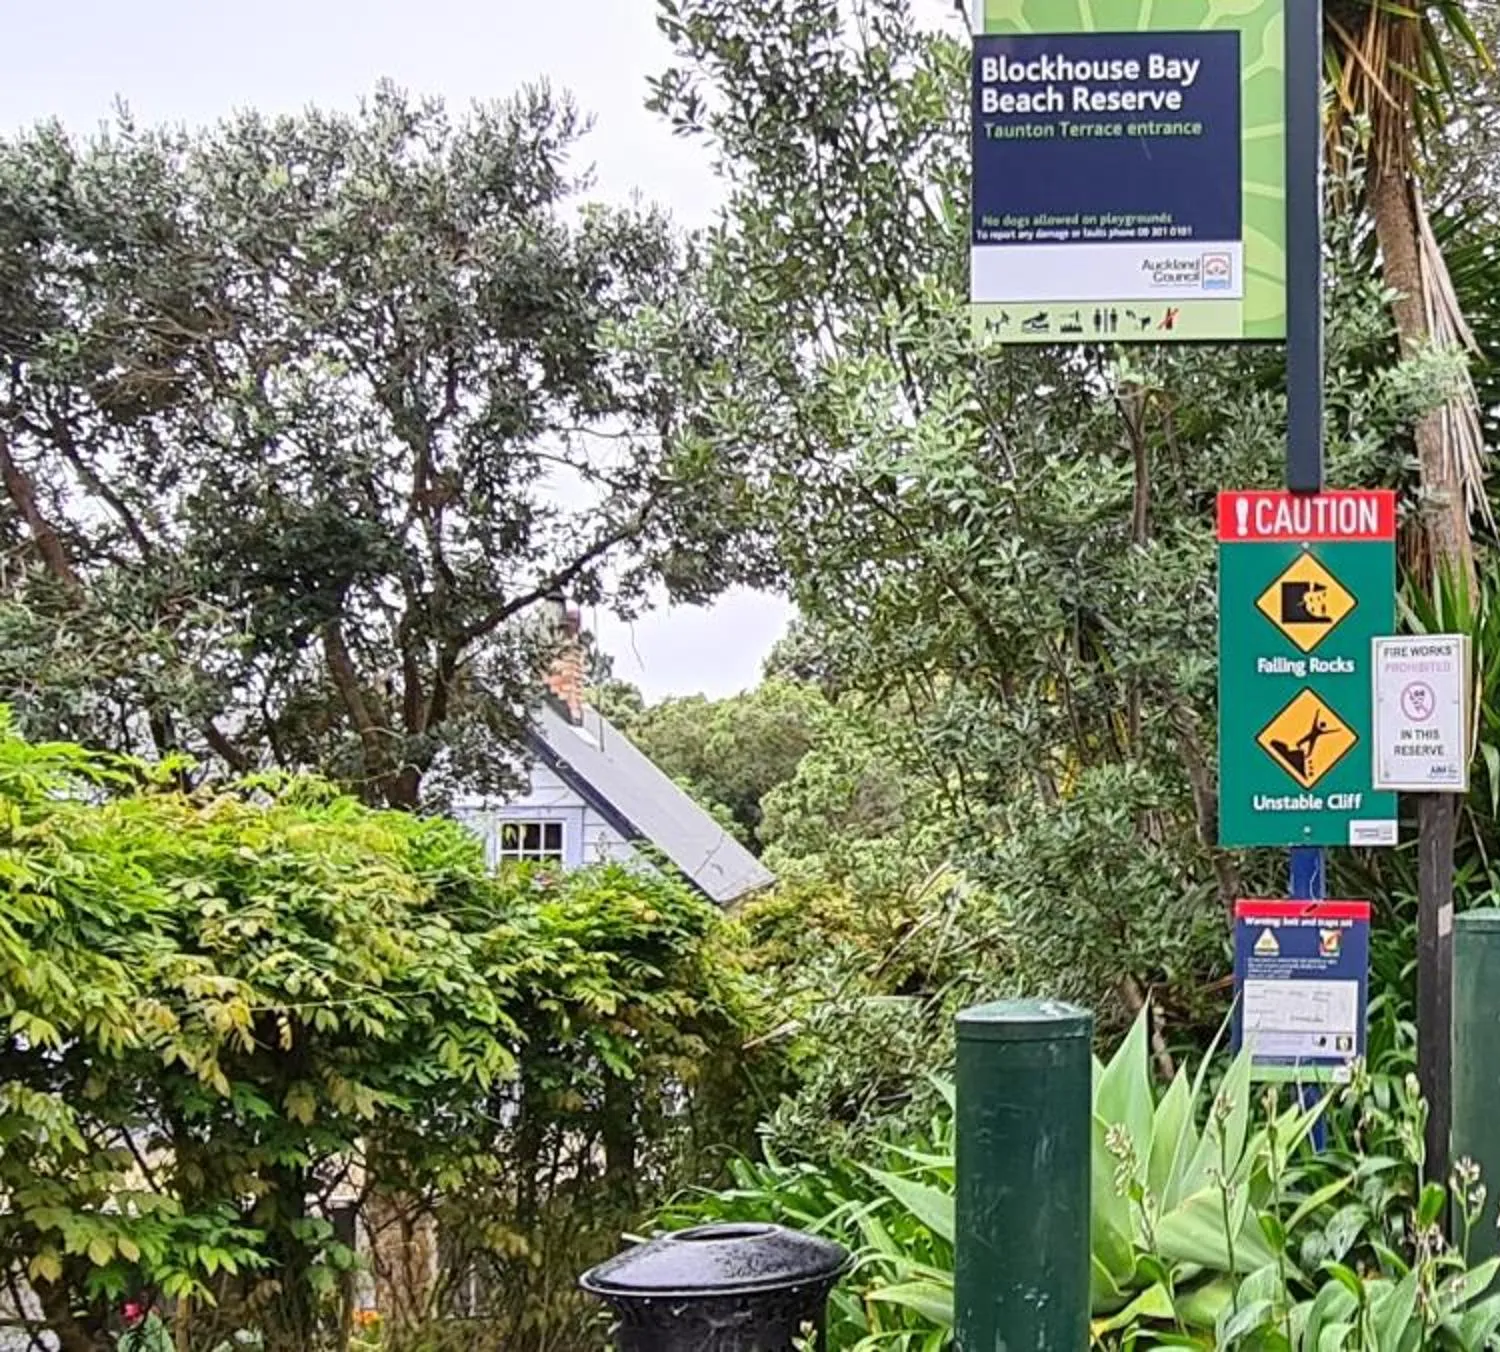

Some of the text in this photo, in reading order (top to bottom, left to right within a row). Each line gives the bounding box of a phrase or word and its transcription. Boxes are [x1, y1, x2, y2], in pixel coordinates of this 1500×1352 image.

[981, 54, 1200, 86] Blockhouse Bay
[982, 86, 1182, 113] Beach Reserve
[984, 120, 1202, 139] Taunton Terrace entrance
[982, 211, 1172, 229] No dogs allowed on playgrounds
[976, 229, 988, 240] To
[989, 229, 1016, 240] report
[1141, 258, 1200, 272] Auckland
[1152, 270, 1200, 283] Council
[1254, 497, 1379, 534] CAUTION
[1383, 645, 1452, 657] FIRE WORKS
[1257, 657, 1355, 677] Falling Rocks
[1385, 662, 1451, 672] PROHIBITED
[1401, 729, 1440, 739] IN THIS
[1394, 745, 1444, 756] RESERVE
[1253, 792, 1363, 811] Unstable Cliff
